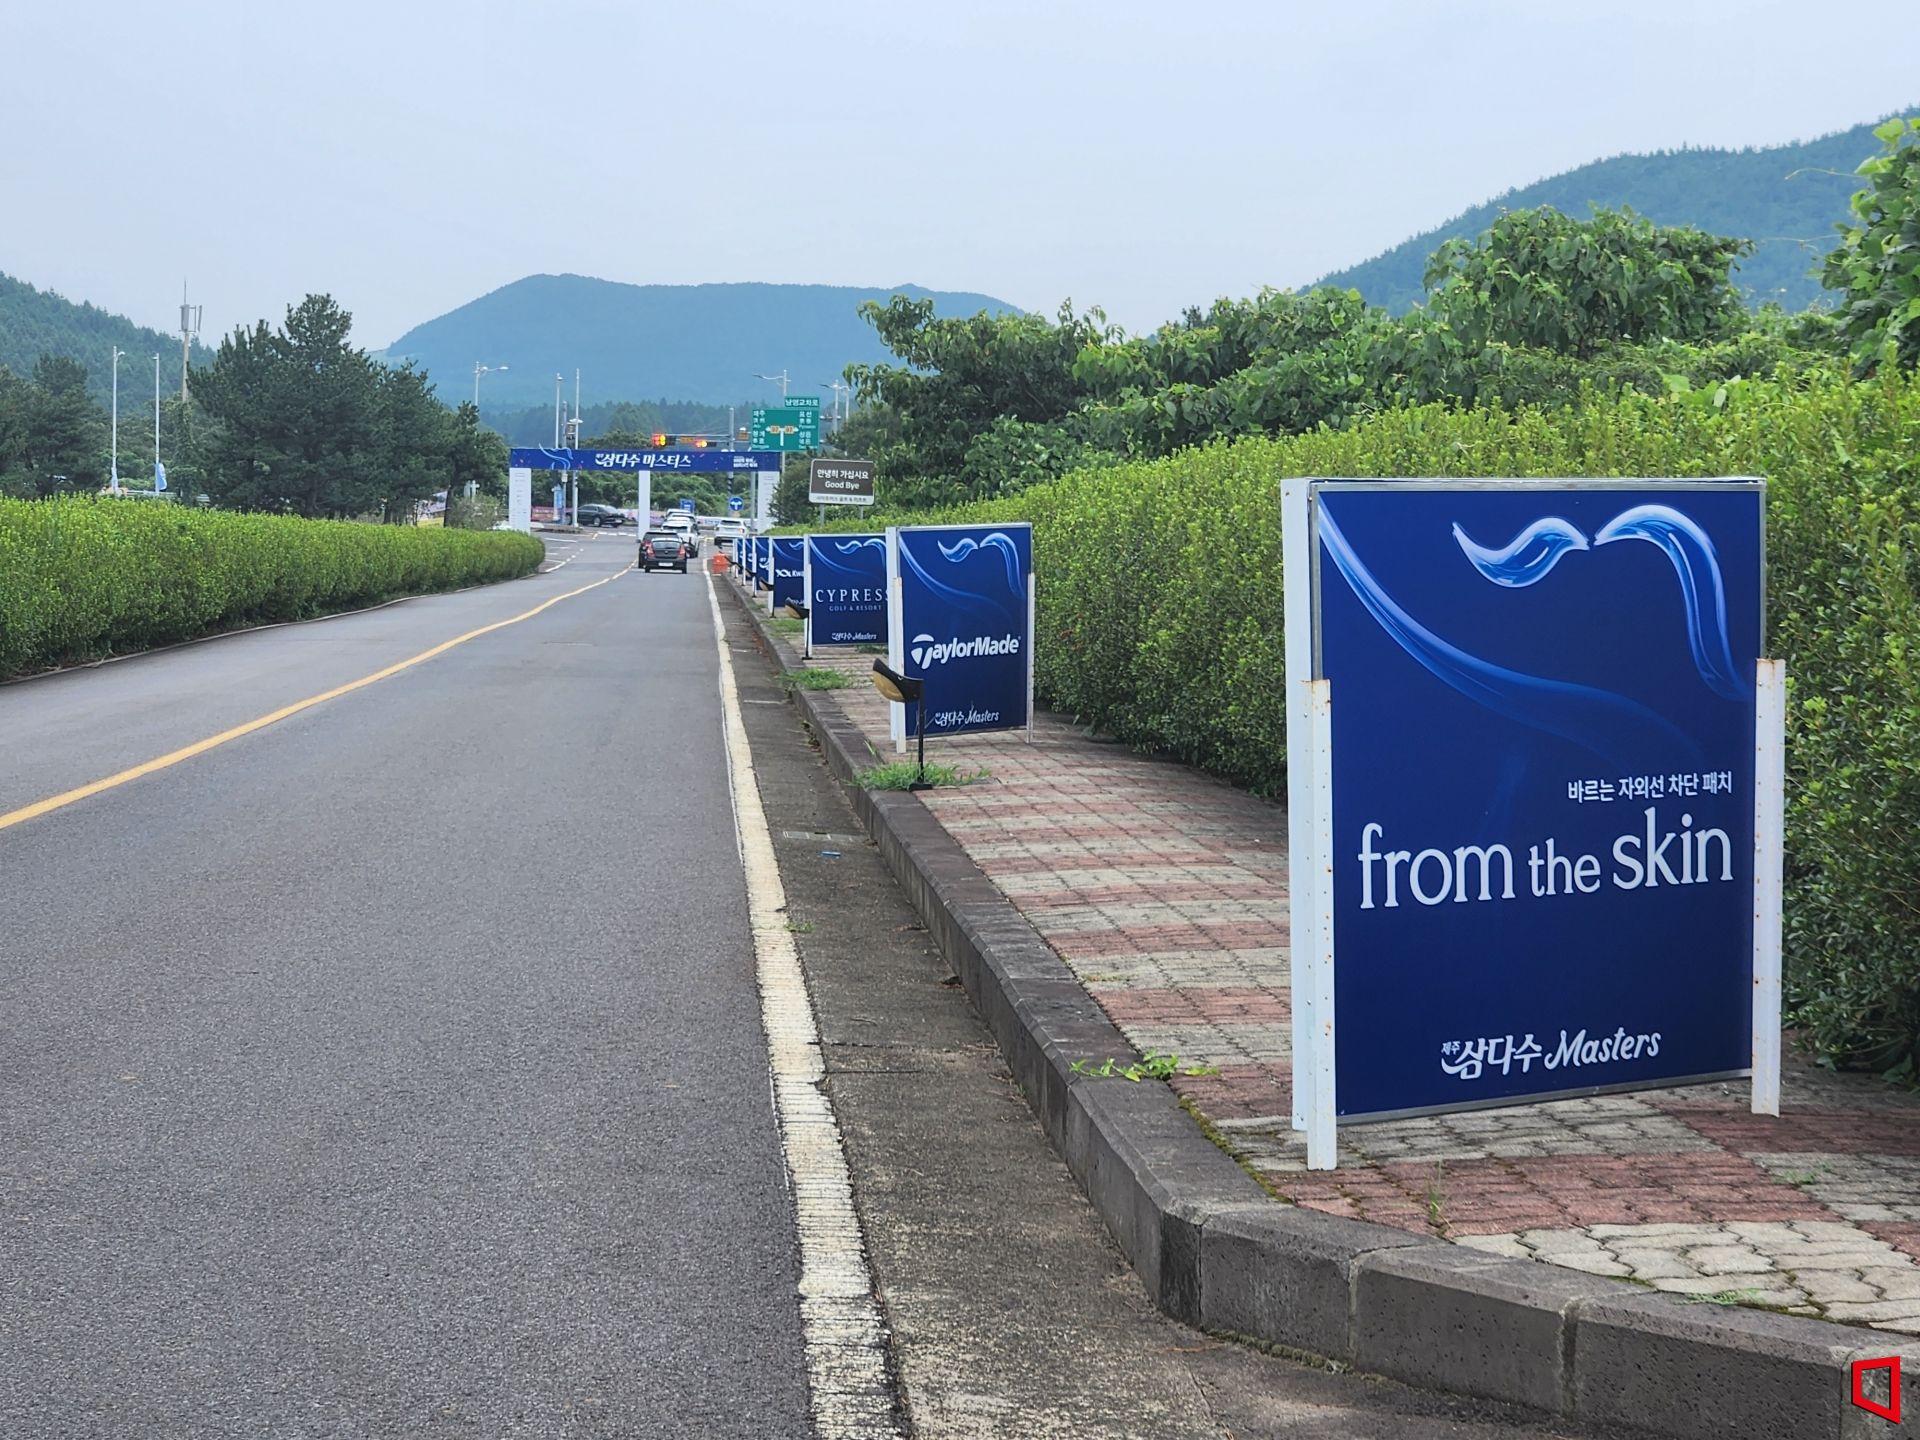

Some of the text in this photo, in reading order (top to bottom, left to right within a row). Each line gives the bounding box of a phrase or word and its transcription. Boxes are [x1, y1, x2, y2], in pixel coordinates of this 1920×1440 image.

[643, 453, 692, 468] 마스터스
[817, 469, 839, 479] 안녕히
[825, 481, 860, 491] Good Bye
[910, 633, 1019, 670] TaylorMade
[965, 709, 1000, 725] Masters
[1568, 770, 1732, 803] 바르는 자외선 차단 패치
[1357, 806, 1734, 909] from the skin
[1441, 1027, 1661, 1080] 삼다수 Masters
